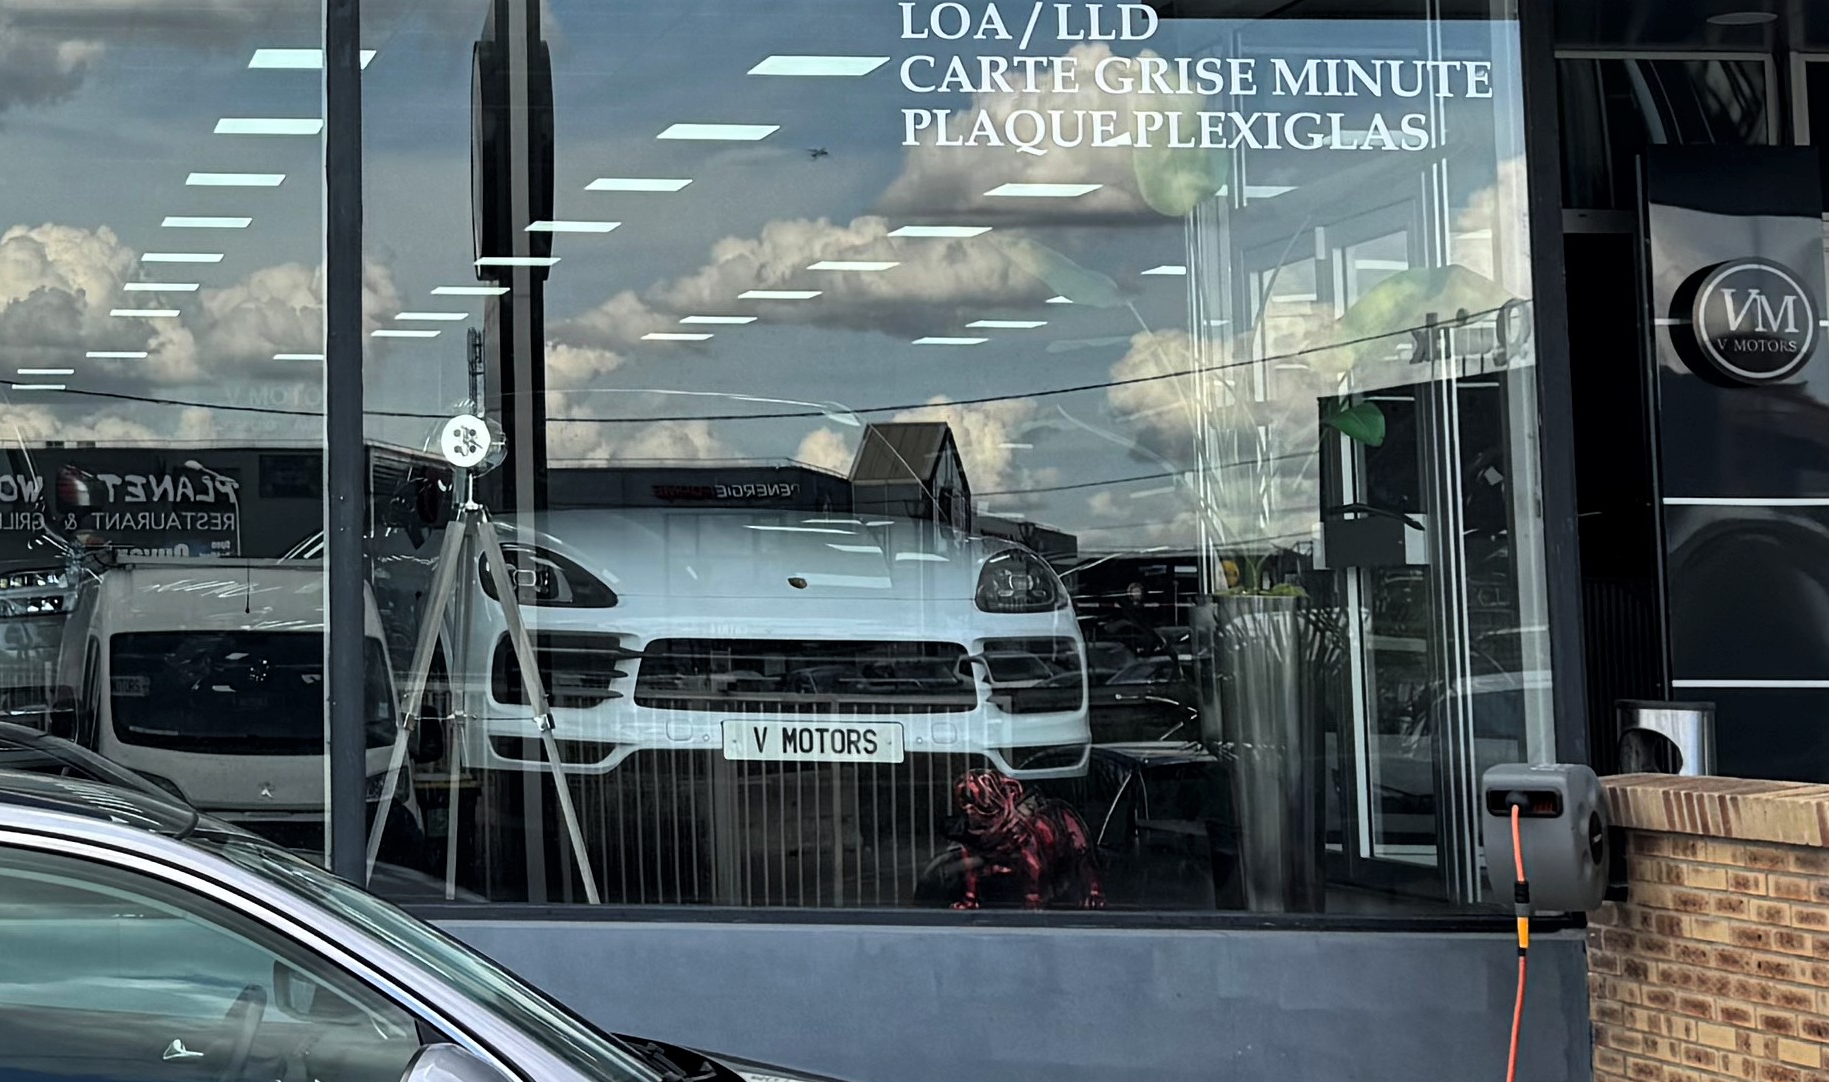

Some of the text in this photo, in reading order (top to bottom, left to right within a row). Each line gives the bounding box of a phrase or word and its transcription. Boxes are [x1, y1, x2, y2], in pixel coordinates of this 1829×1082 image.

[900, 55, 1493, 98] CARTE GRISE MINUTE
[901, 109, 1429, 156] PLAQUE PLEXIGLAS
[1721, 288, 1799, 333] VM
[1717, 339, 1798, 353] V MOTORS
[753, 726, 878, 754] V MOTORS
